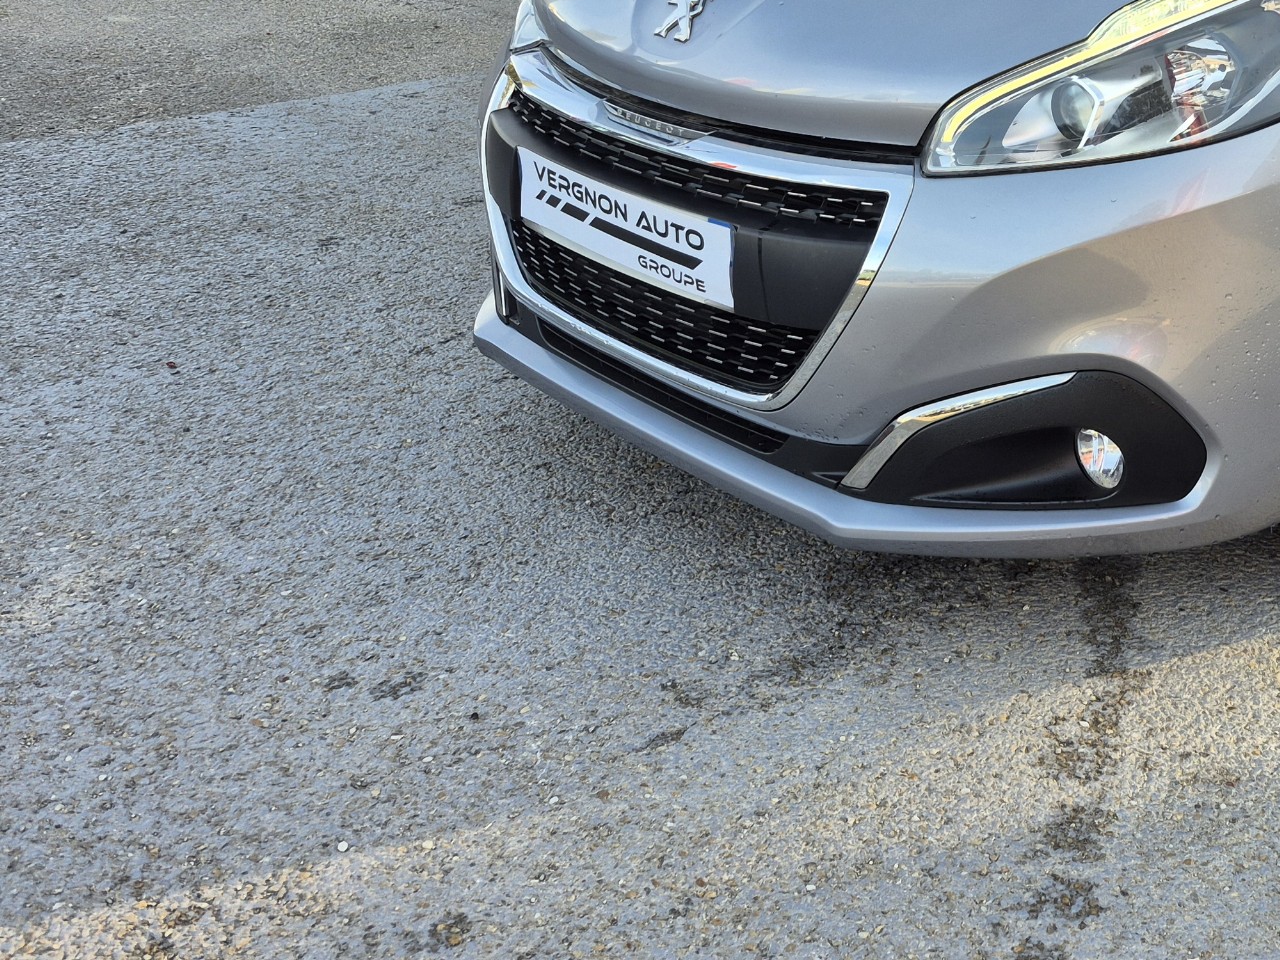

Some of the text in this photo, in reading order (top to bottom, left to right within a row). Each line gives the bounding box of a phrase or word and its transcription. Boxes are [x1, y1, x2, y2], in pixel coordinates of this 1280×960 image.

[616, 108, 685, 137] PEUGEOT
[533, 161, 705, 250] VERGNON AUTO
[638, 254, 707, 293] GROUPE
